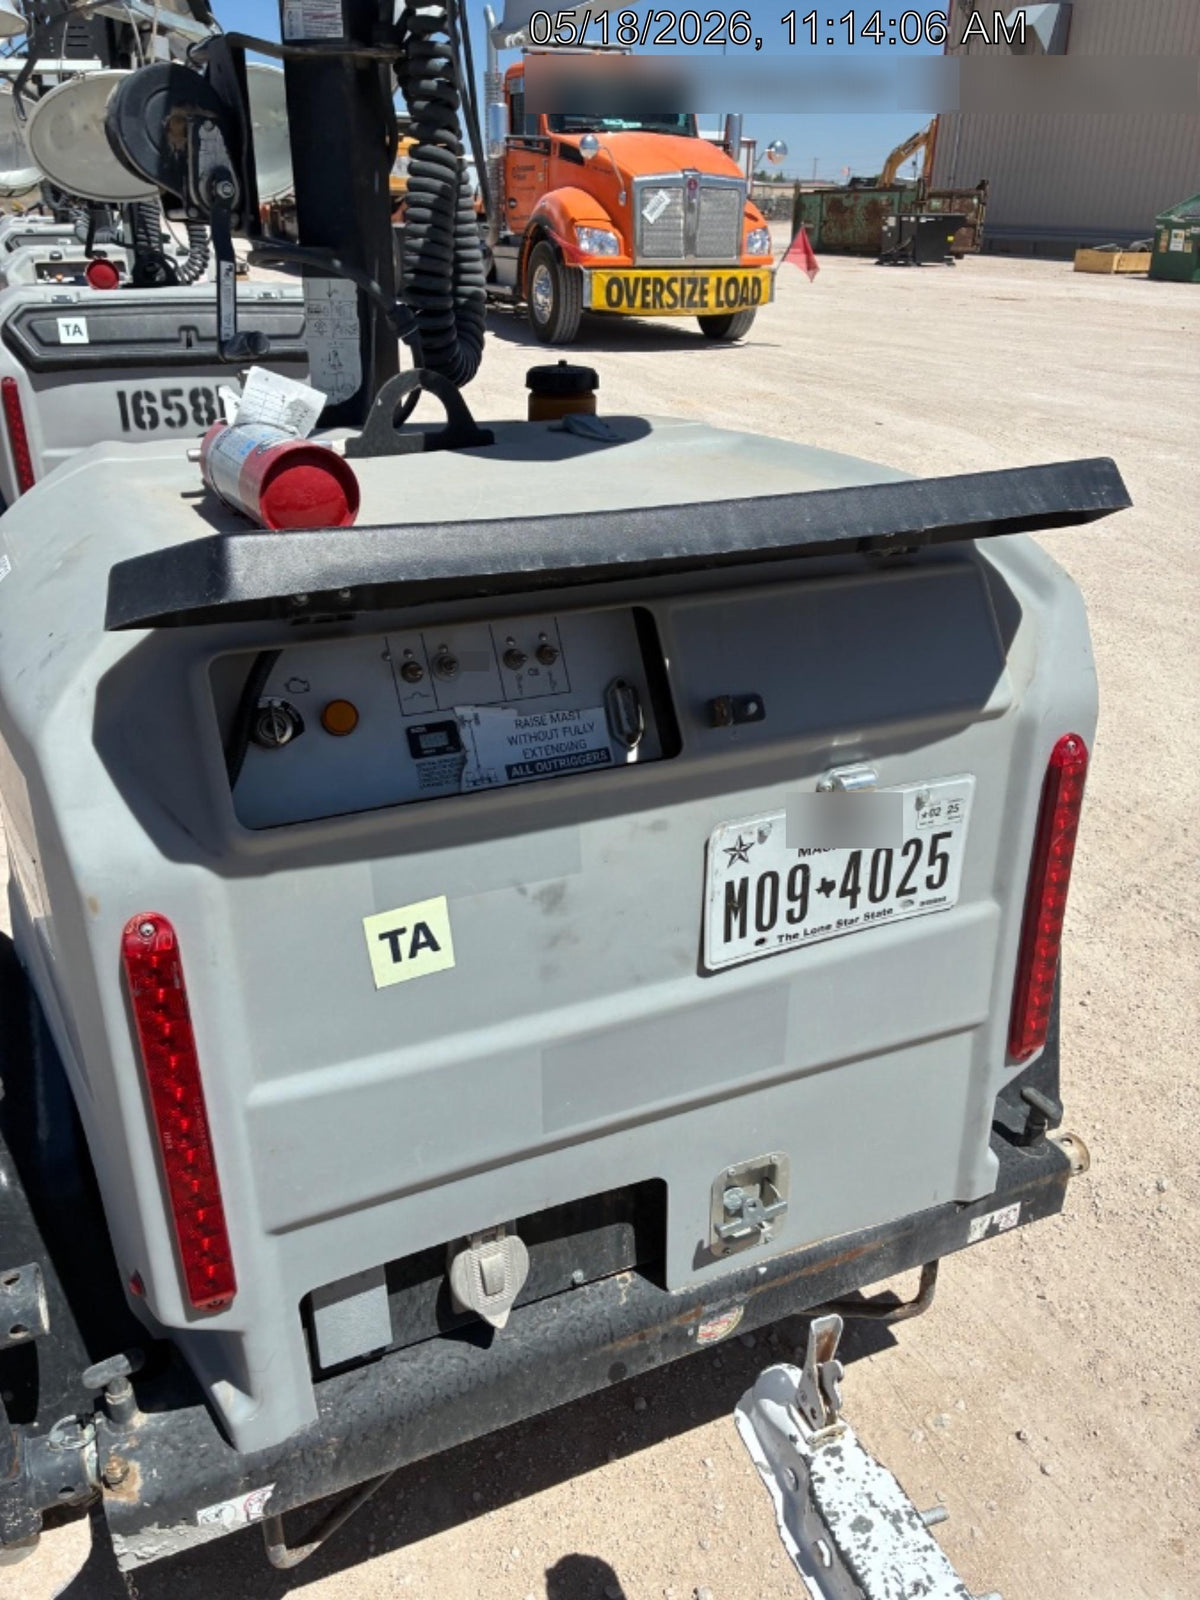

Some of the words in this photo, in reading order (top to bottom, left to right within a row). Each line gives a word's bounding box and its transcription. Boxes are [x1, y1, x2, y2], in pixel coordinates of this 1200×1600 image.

[605, 276, 710, 309] OVERSIZE
[715, 276, 762, 308] LOAD
[61, 323, 84, 337] TA
[514, 716, 548, 730] RAISE
[549, 711, 582, 725] MAST
[507, 729, 559, 747] WITHOUT
[562, 722, 595, 737] FULLY
[522, 739, 587, 760] EXTENDING
[511, 764, 533, 777] ALL
[535, 751, 609, 773] OUTRIGGERS
[777, 933, 799, 944] The
[803, 923, 833, 937] Lone
[836, 916, 860, 929] Star
[863, 907, 894, 921] State
[378, 921, 441, 963] TA
